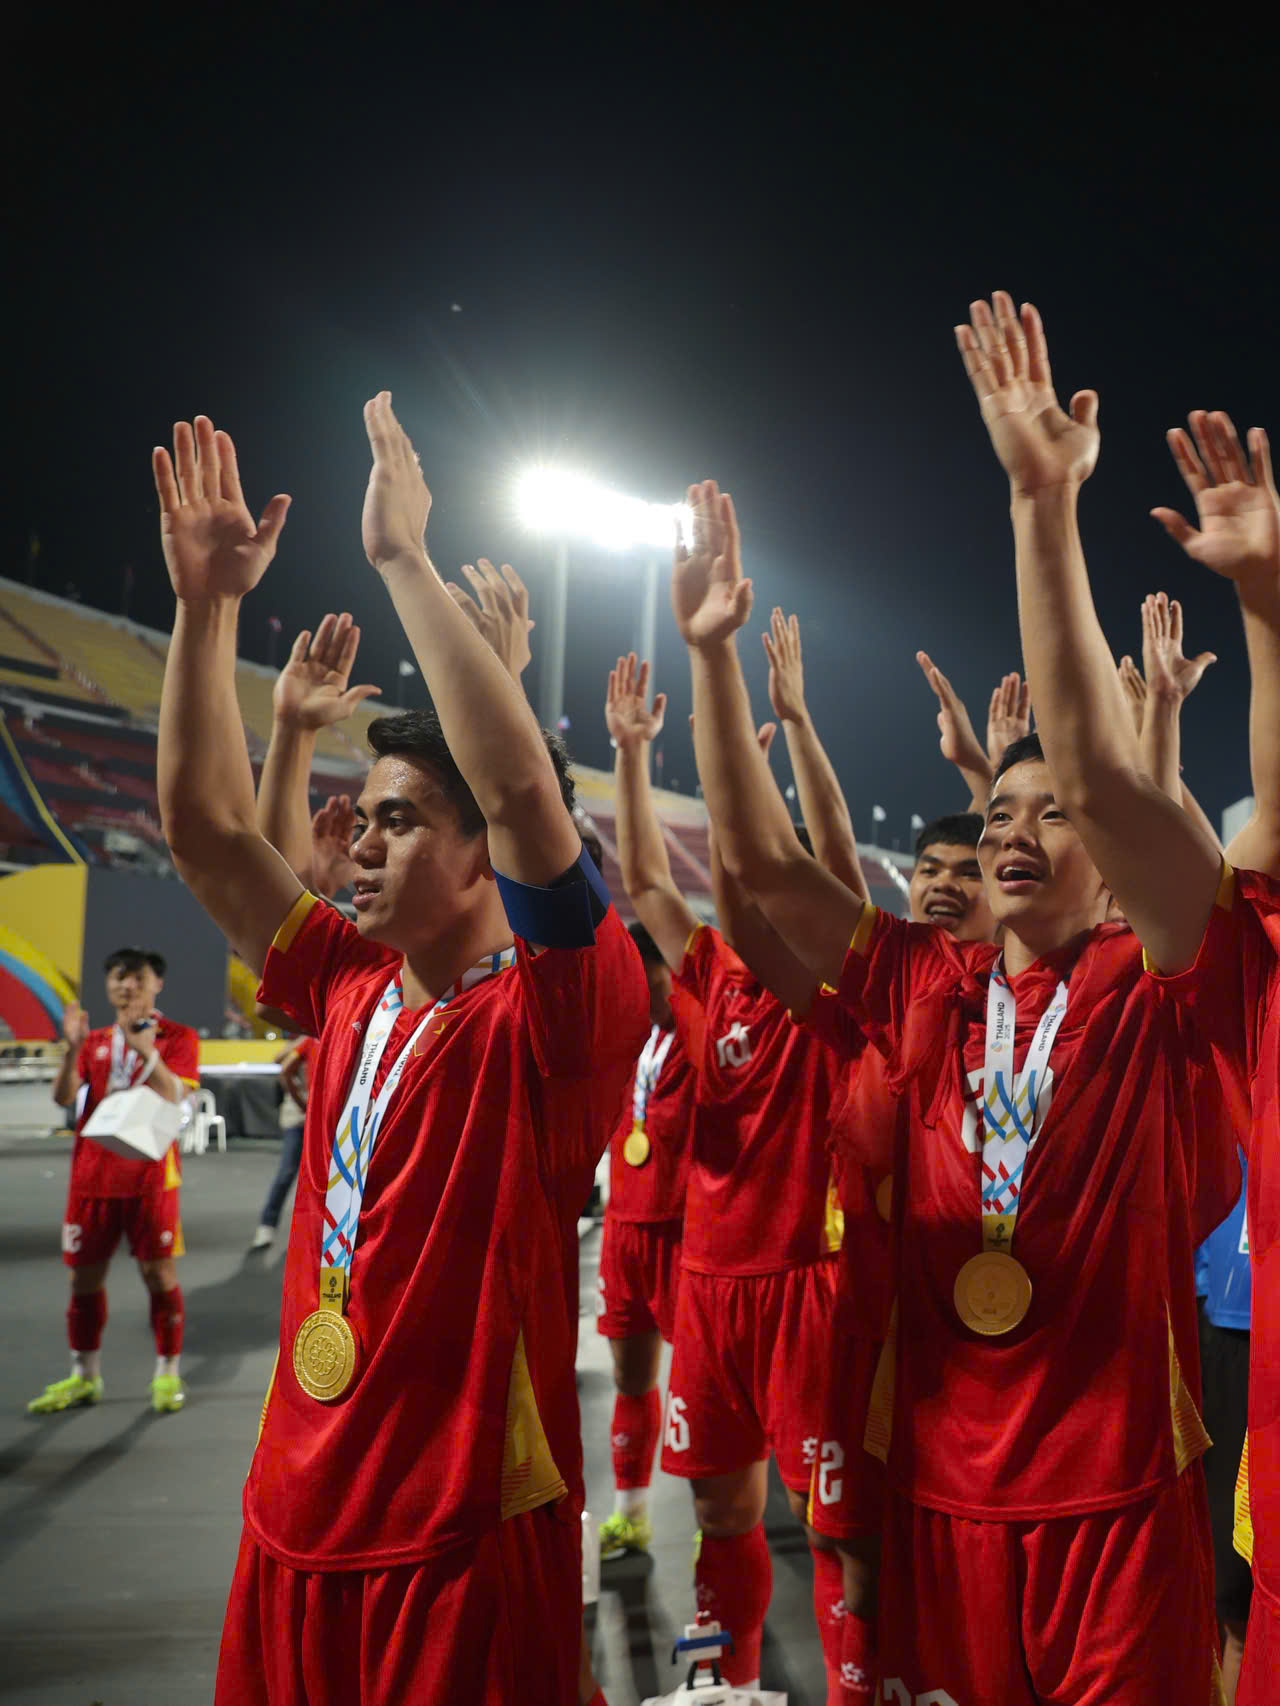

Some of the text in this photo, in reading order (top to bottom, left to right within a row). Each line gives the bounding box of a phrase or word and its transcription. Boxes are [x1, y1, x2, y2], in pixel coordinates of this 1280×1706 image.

[995, 1001, 1006, 1040] THAILAND
[1037, 1014, 1057, 1052] THAILAND
[359, 1042, 379, 1085] THAILAND
